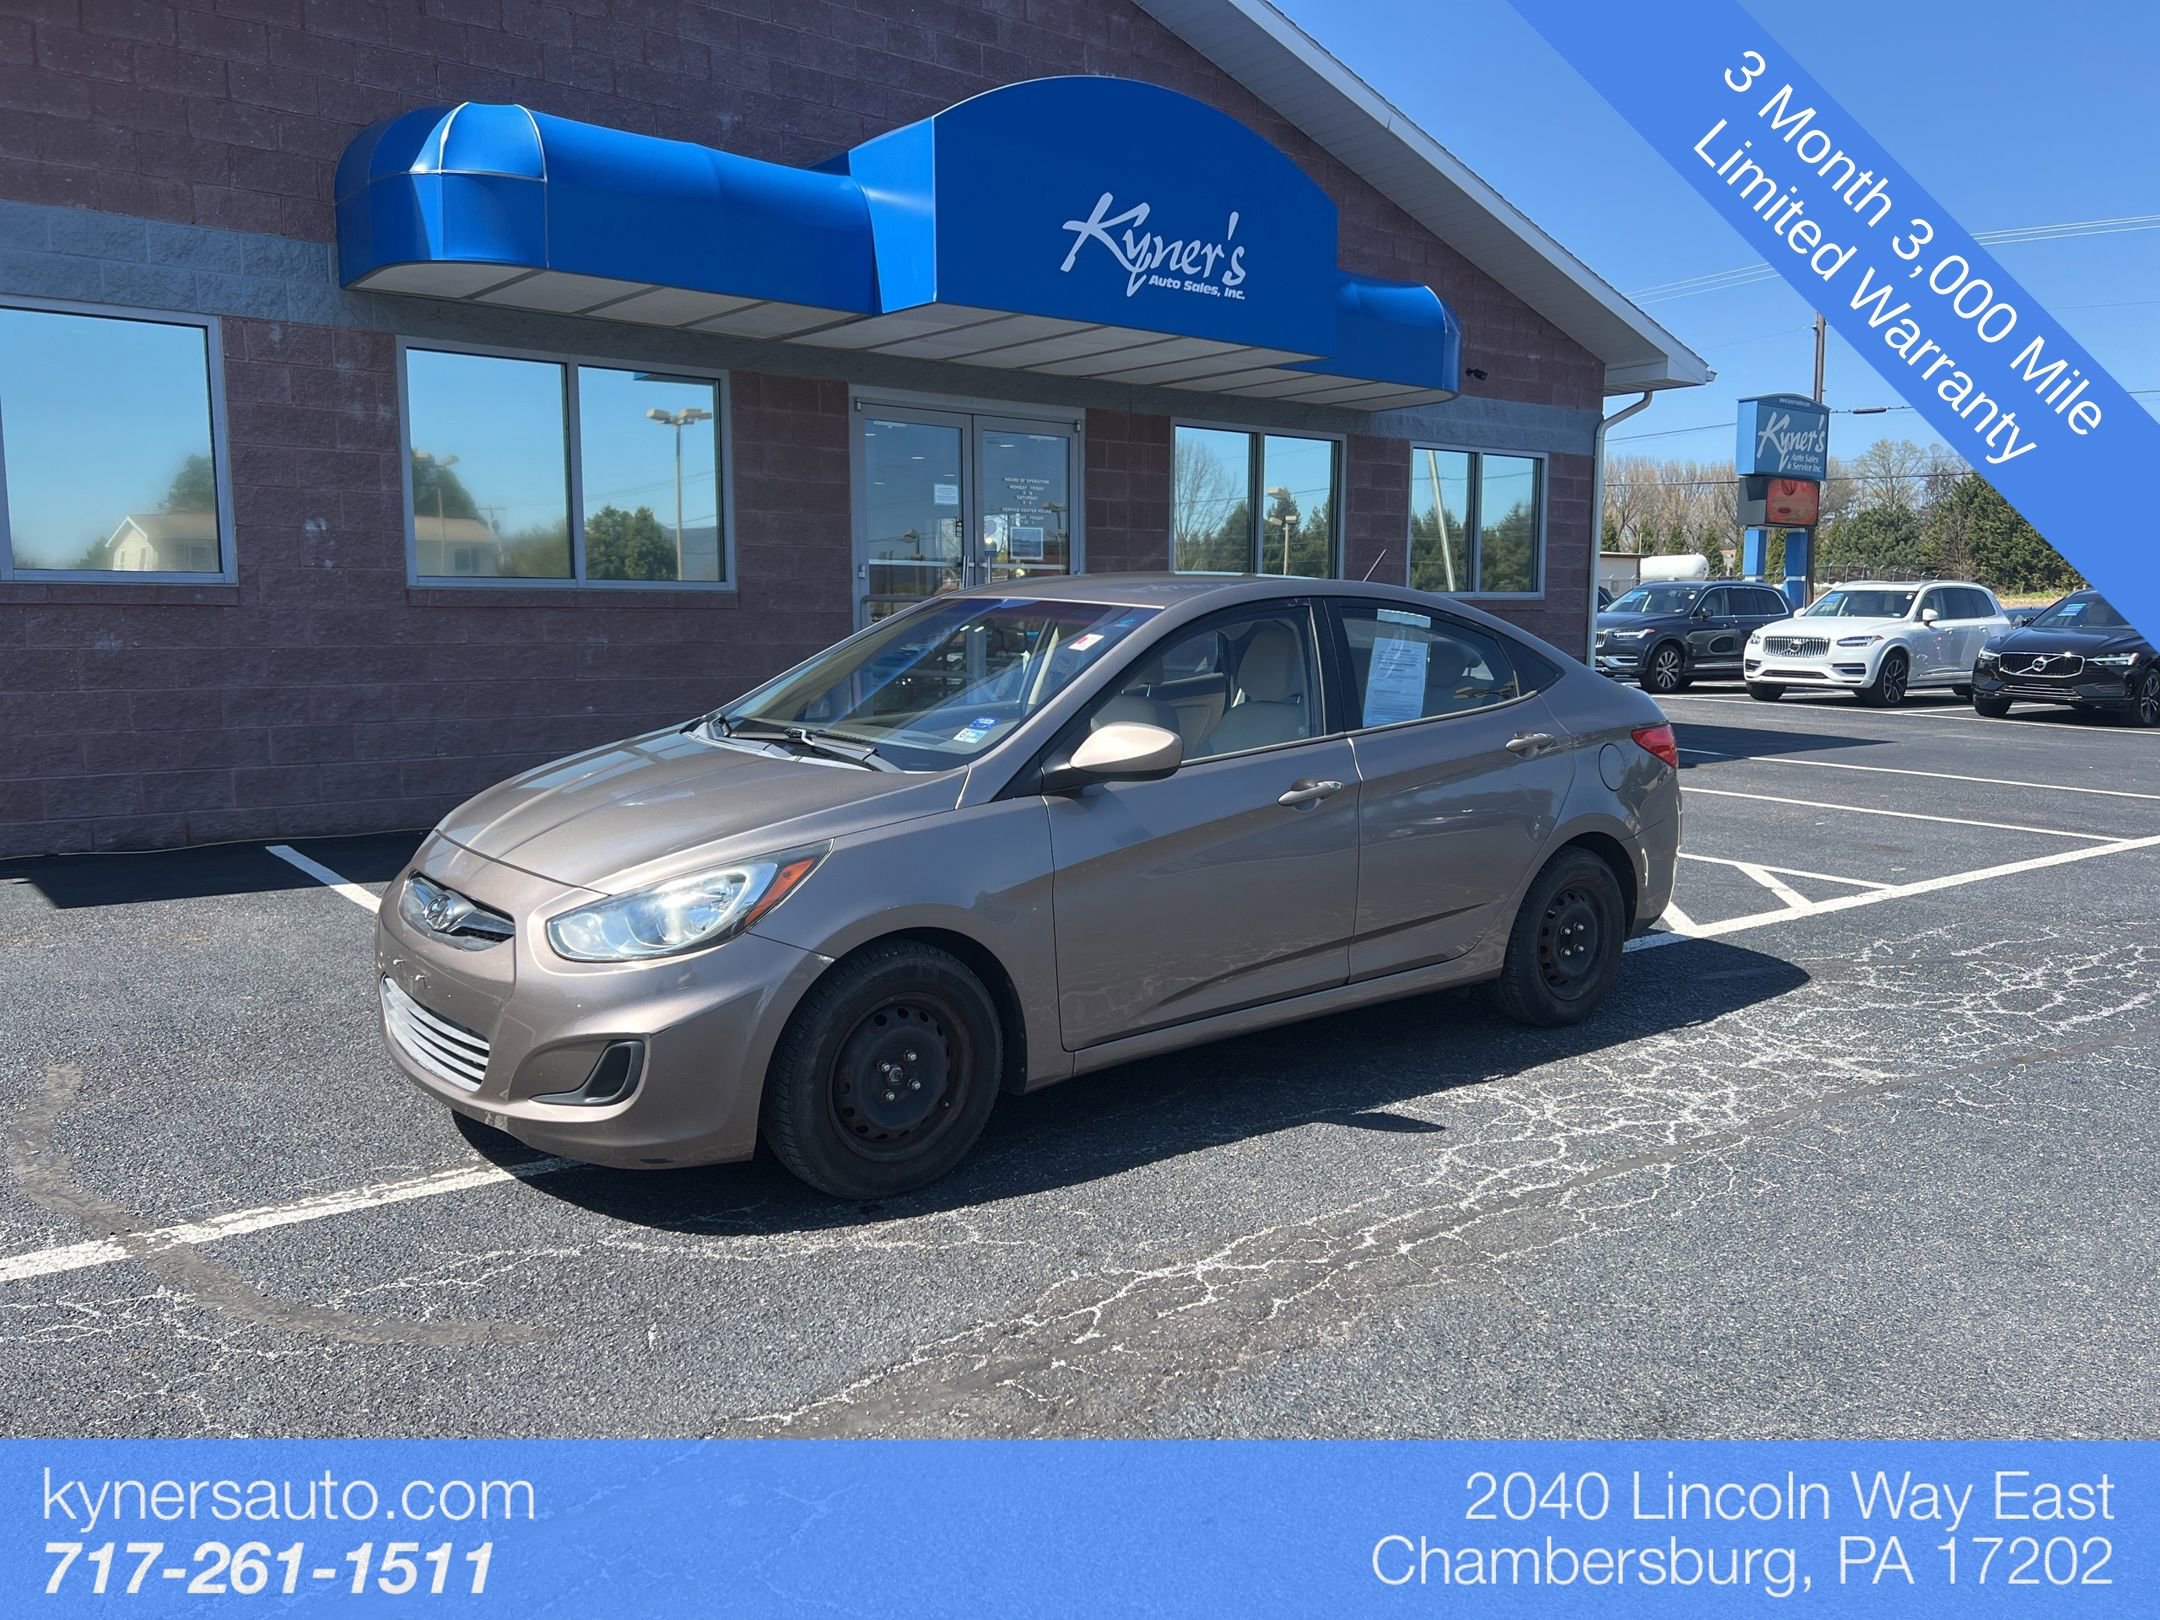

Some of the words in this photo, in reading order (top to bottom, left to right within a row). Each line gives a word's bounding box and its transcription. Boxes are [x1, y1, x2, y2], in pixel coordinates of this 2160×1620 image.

[1060, 192, 1246, 297] Kyner's
[1149, 274, 1181, 289] Auto
[1184, 280, 1221, 297] Sales,
[1224, 287, 1246, 300] Inc.
[1757, 411, 1825, 472] Kyner's
[1791, 454, 1805, 462] Auto
[1805, 455, 1819, 464] Sales
[1792, 462, 1812, 472] Service
